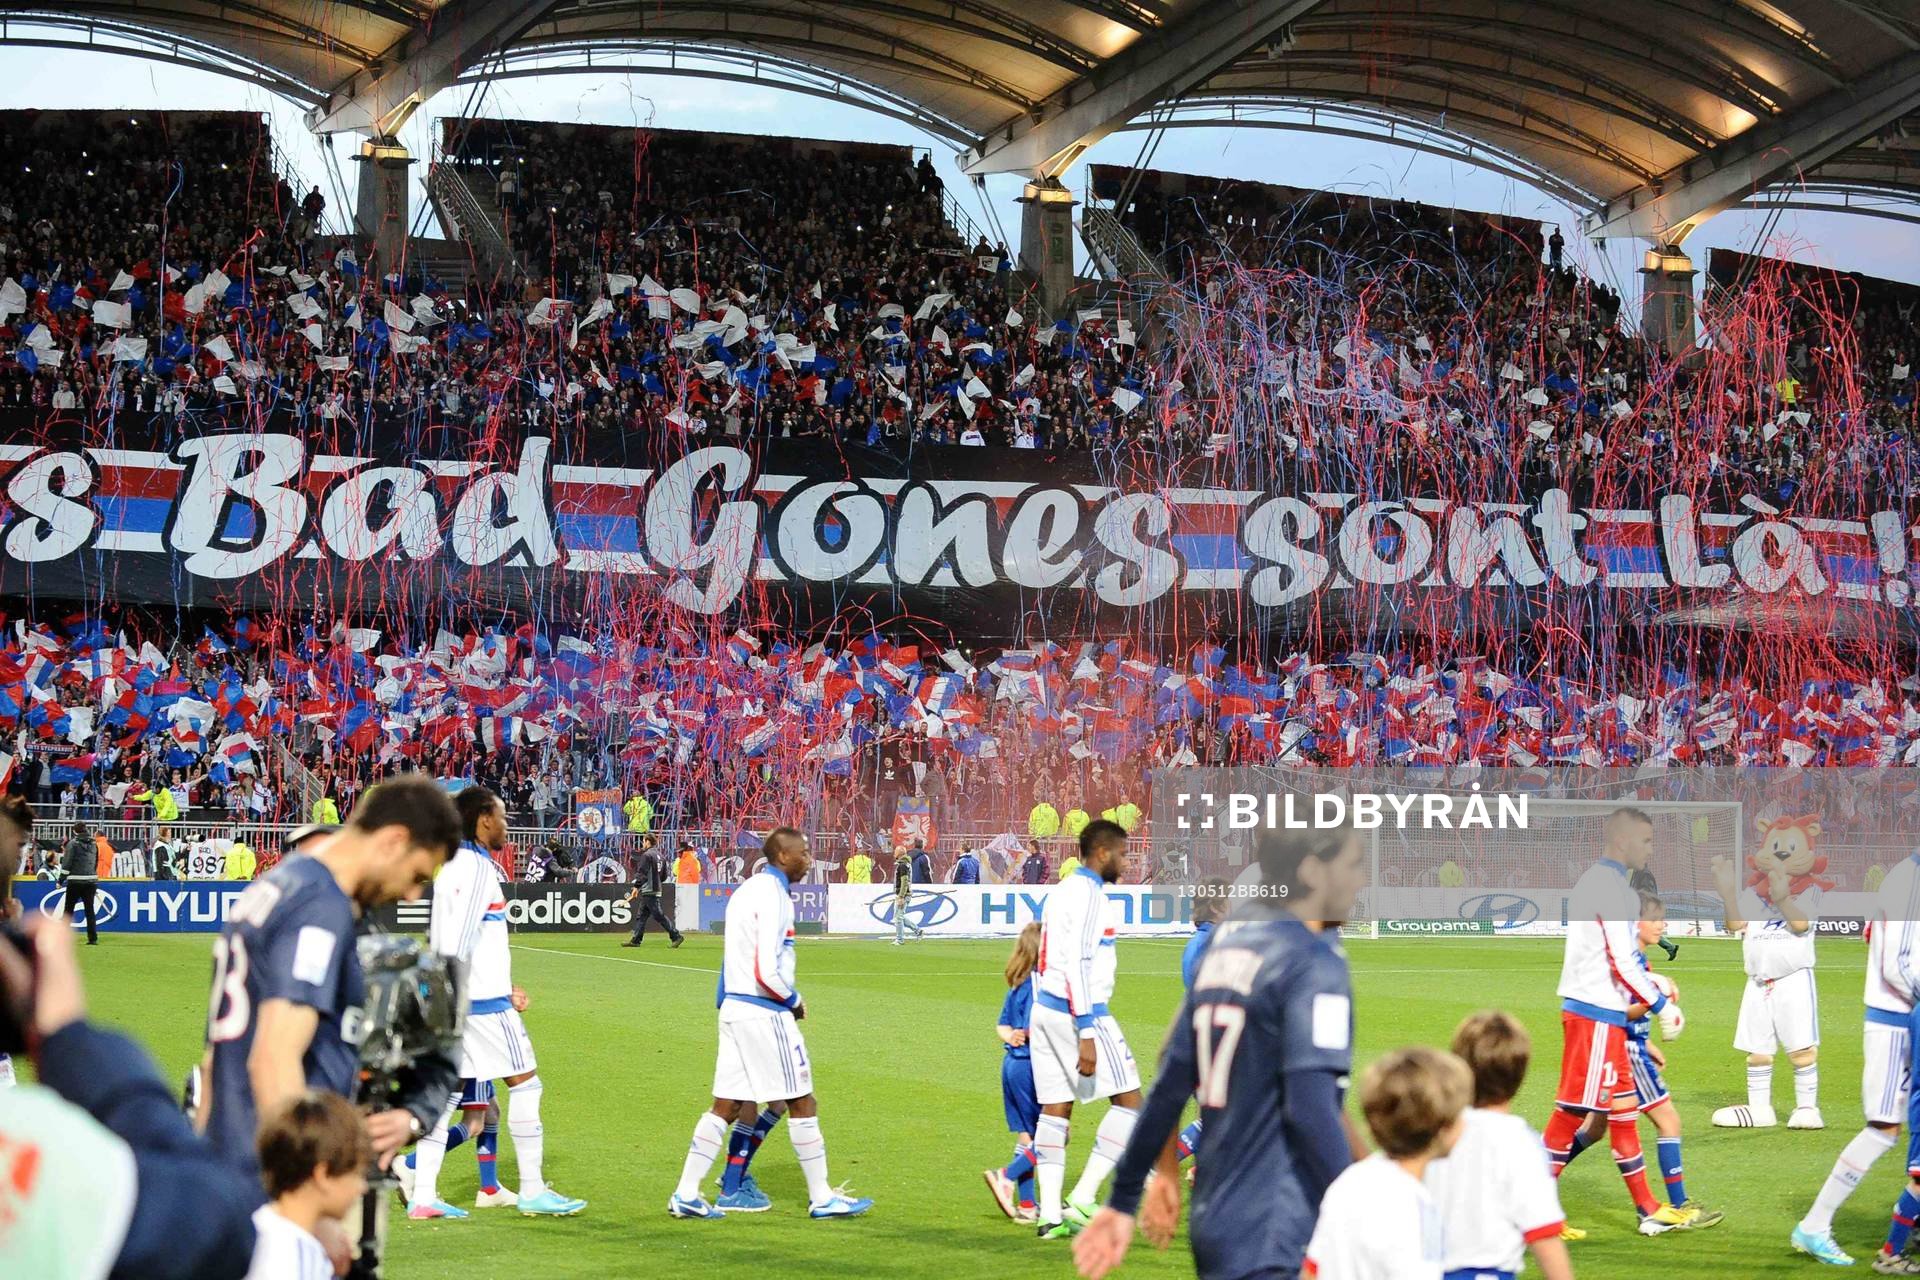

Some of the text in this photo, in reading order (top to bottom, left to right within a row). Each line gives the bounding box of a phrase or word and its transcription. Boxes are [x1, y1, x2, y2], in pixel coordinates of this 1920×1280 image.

[170, 433, 559, 579] Bad
[645, 446, 1180, 615] Gones
[1244, 488, 1599, 606] sont
[1661, 493, 1828, 595] Là
[505, 891, 632, 924] adidas
[1386, 920, 1480, 934] Groupama
[1192, 1003, 1246, 1108] 17
